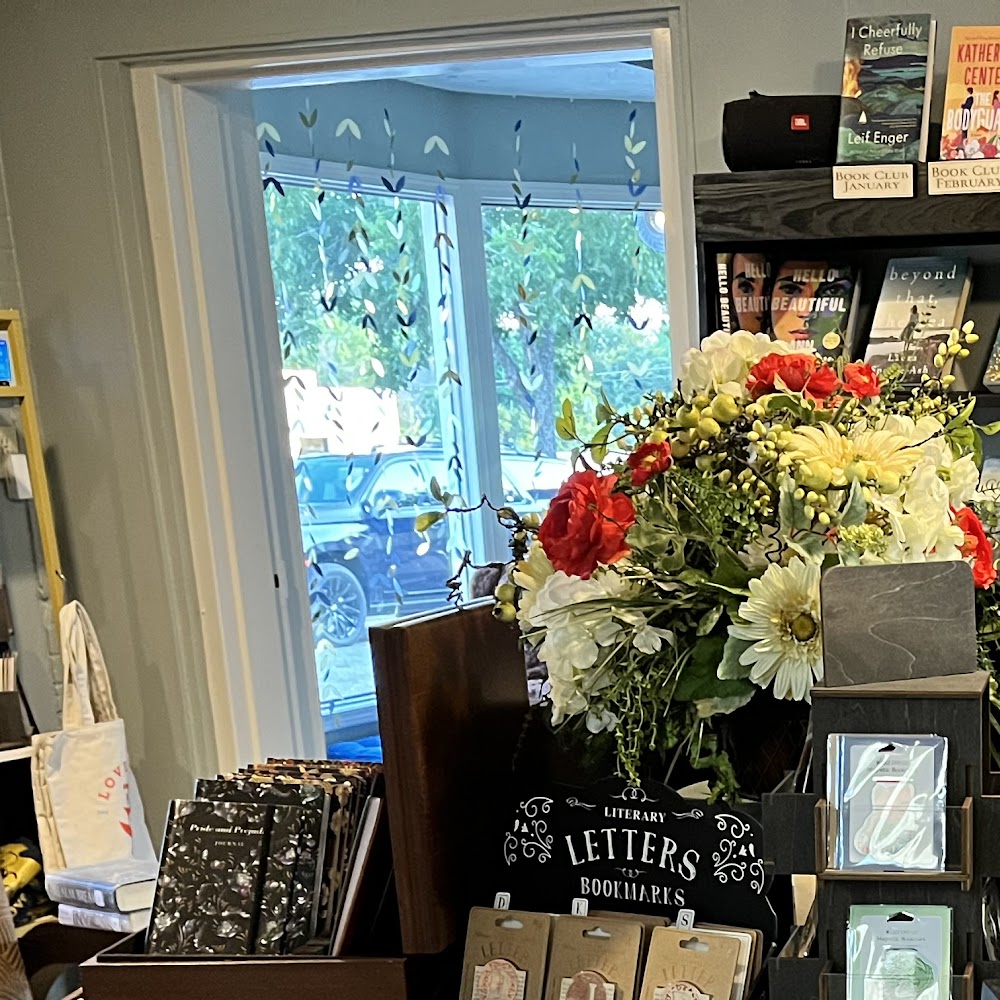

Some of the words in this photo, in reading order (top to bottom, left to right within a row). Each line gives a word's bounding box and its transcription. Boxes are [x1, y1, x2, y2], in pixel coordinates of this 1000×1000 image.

[859, 23, 922, 40] Cheerfully
[864, 44, 903, 56] Refuse
[974, 92, 992, 106] THE
[848, 132, 870, 145] Leif
[873, 131, 909, 146] Enger
[836, 171, 870, 182] BOOK
[874, 170, 909, 181] CLUB
[932, 166, 968, 178] BOOK
[843, 182, 900, 193] JANUARY
[792, 268, 839, 282] HELLO
[890, 264, 957, 286] beyond
[896, 289, 938, 304] that,
[772, 298, 846, 312] BEAUTIFUL
[604, 806, 666, 824] LITERARY
[190, 824, 214, 833] Pride
[215, 826, 233, 834] and
[565, 828, 700, 882] LETTERS
[580, 876, 685, 907] BOOKMARKS
